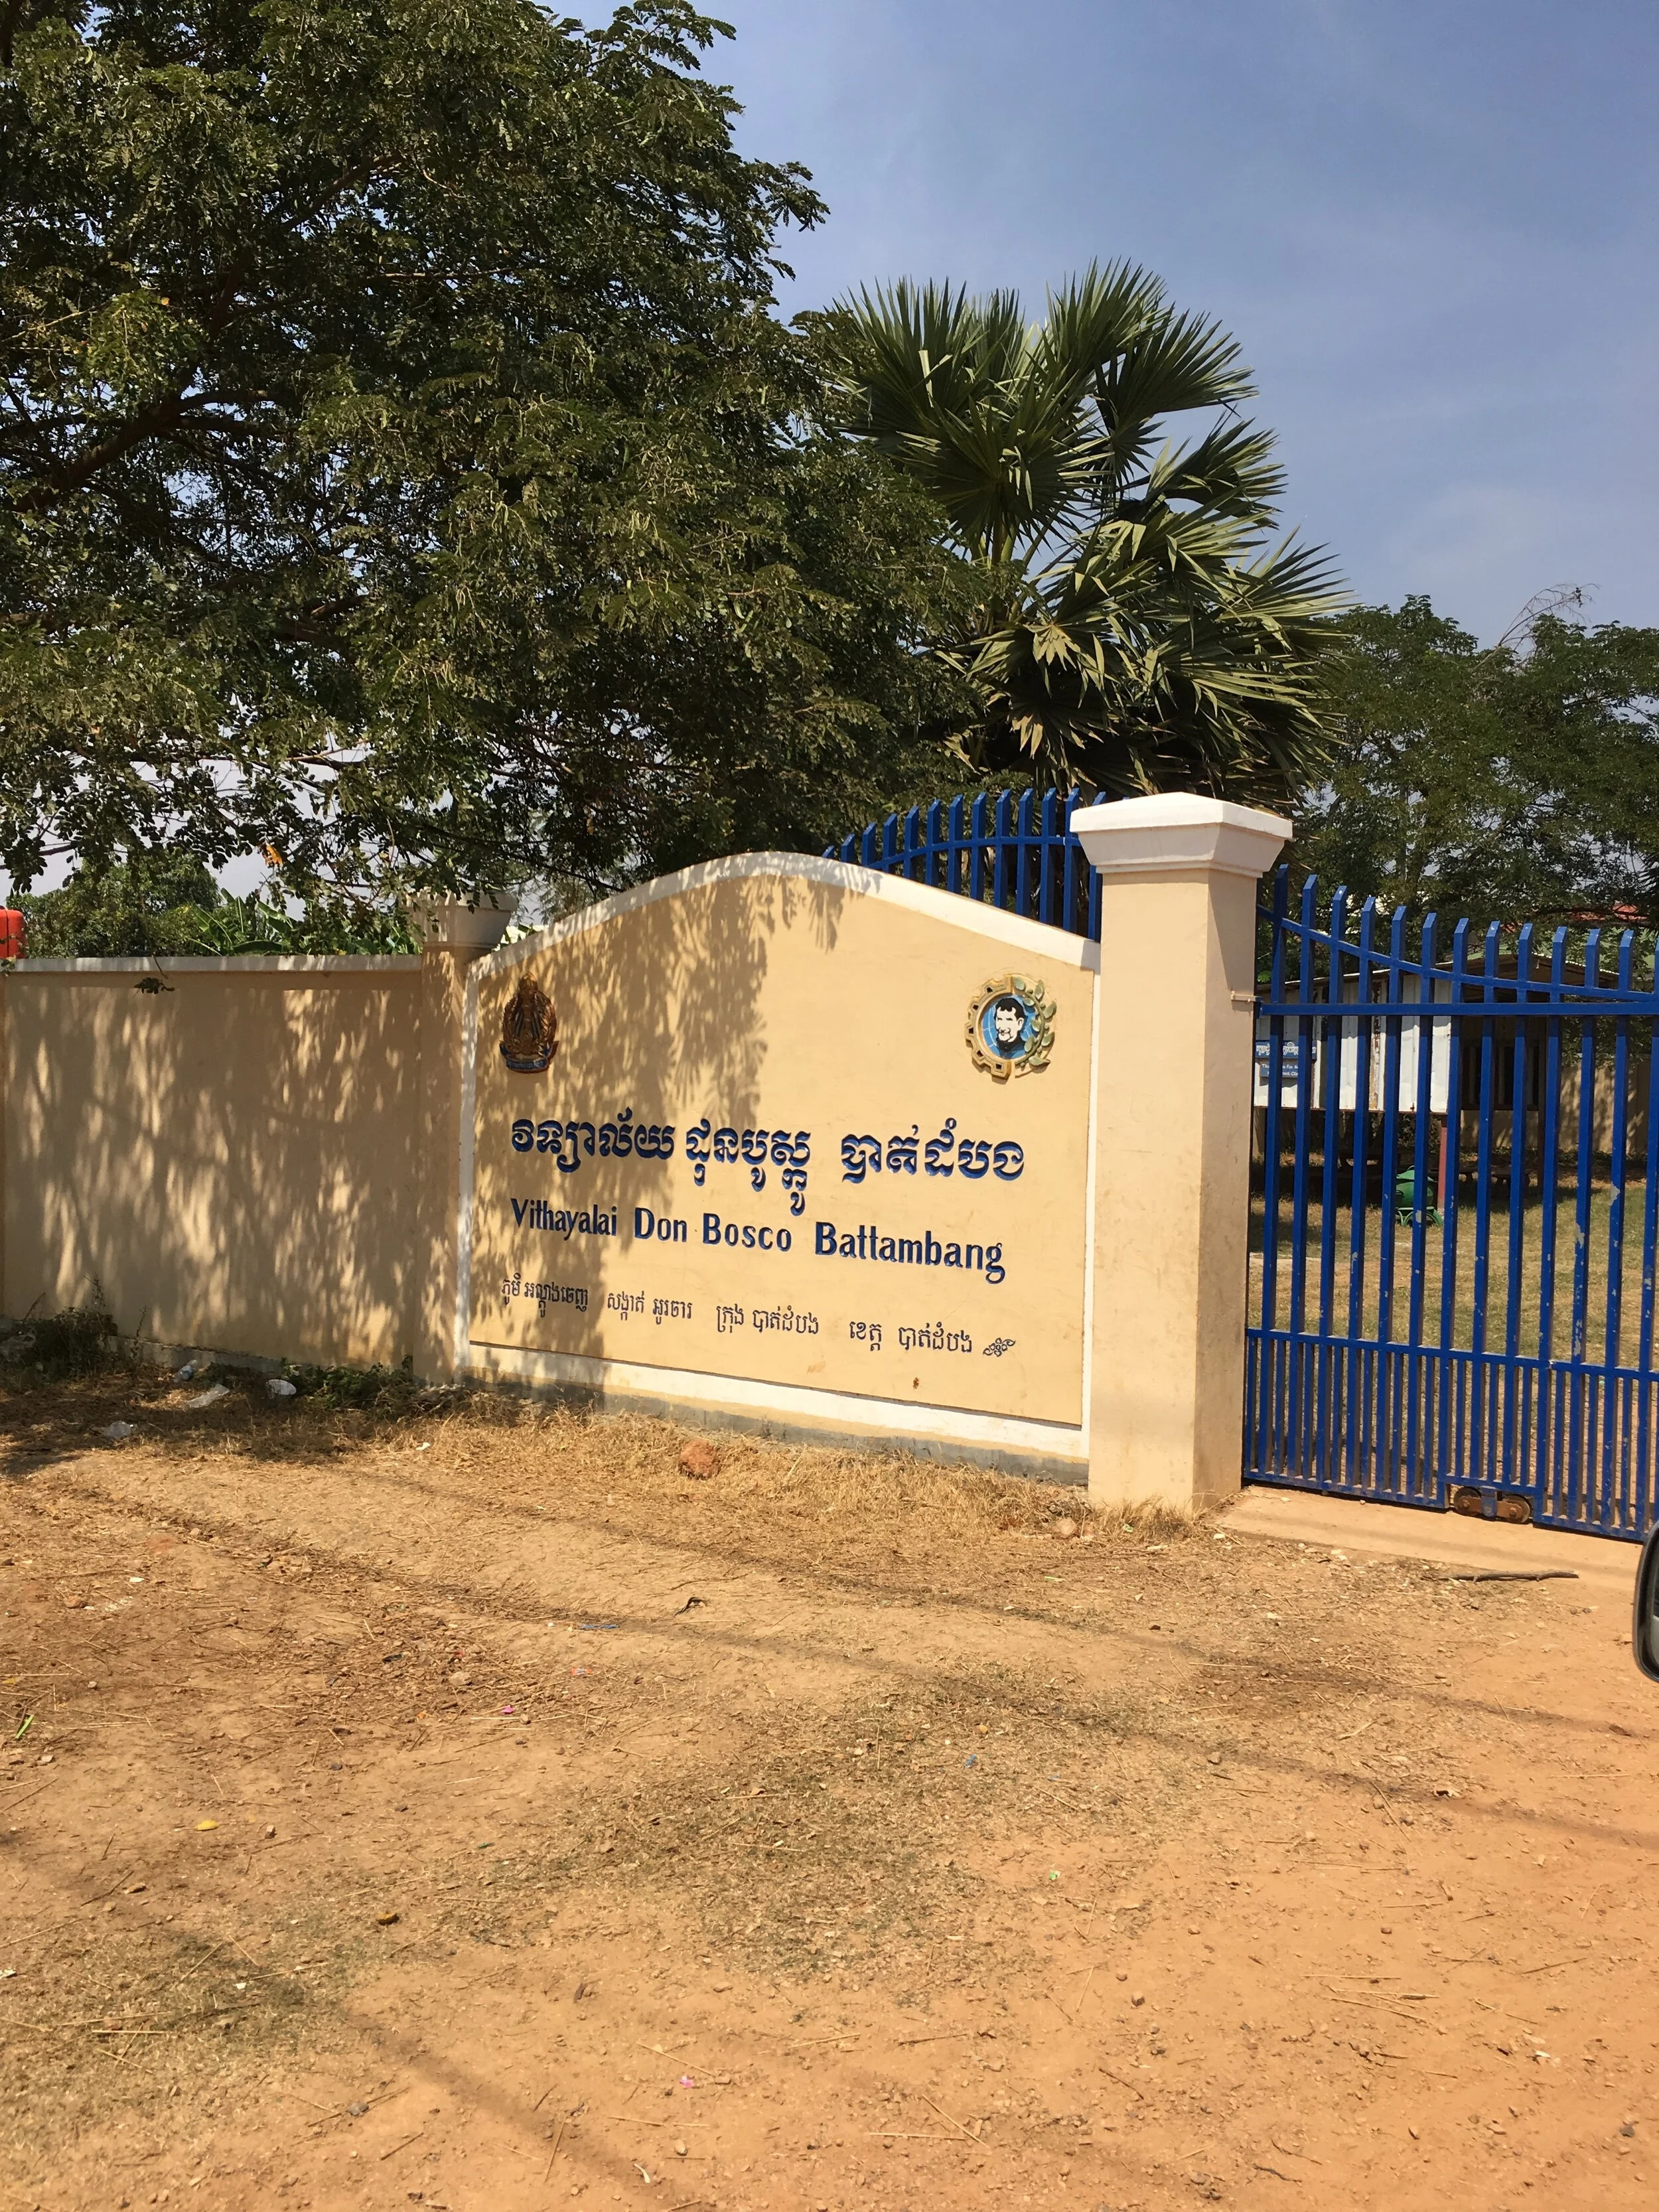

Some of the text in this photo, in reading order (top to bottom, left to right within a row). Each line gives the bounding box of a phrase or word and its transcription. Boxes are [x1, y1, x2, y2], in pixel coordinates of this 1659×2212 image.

[511, 1107, 676, 1173] វិទ្យាល័យ
[841, 1118, 1025, 1183] បាត់ដំបង
[510, 1198, 1005, 1284] Vithayalai Don Bosco Battambang
[502, 1272, 522, 1305] ភូមិ
[607, 1291, 644, 1321] សង្កាត់
[652, 1298, 693, 1325] អូរចារ
[716, 1303, 745, 1333] ក្រុង
[753, 1305, 819, 1335] បាត់ដំបង
[849, 1321, 882, 1351] ខេត្ត
[899, 1321, 972, 1353] បាត់ដំបង
